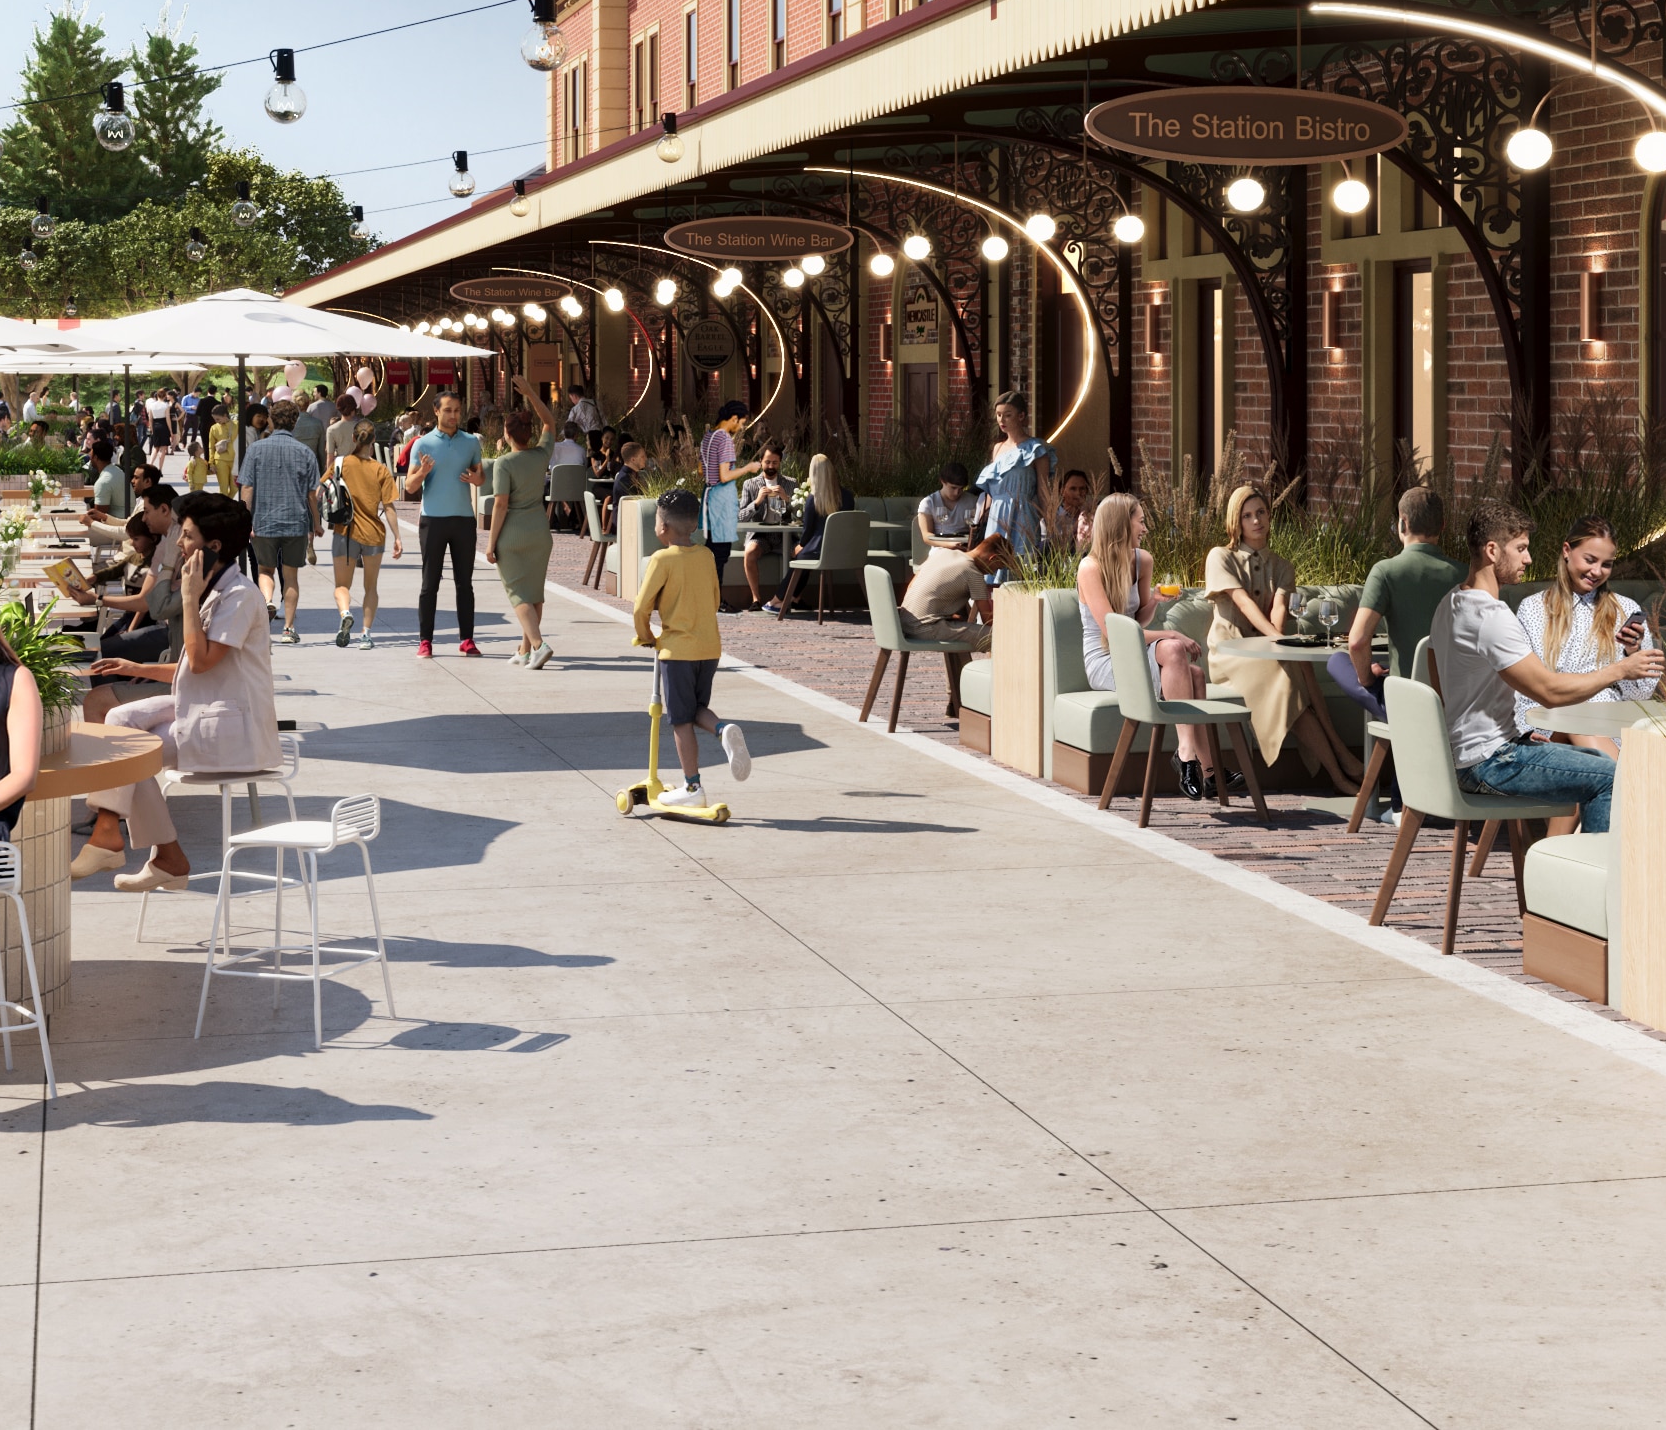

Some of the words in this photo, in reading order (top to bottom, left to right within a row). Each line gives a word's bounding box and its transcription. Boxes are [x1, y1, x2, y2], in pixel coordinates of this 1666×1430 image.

[1128, 112, 1181, 138] The
[1191, 113, 1284, 140] Station
[1296, 116, 1371, 141] Bistro
[685, 232, 712, 246] The
[717, 232, 765, 247] Station
[770, 233, 806, 247] Wine
[810, 233, 835, 247] Bar
[464, 287, 481, 297] The
[484, 287, 515, 297] Station
[519, 288, 542, 297] Wine
[544, 288, 561, 297] Bar
[907, 308, 935, 322] NEWCASTLE
